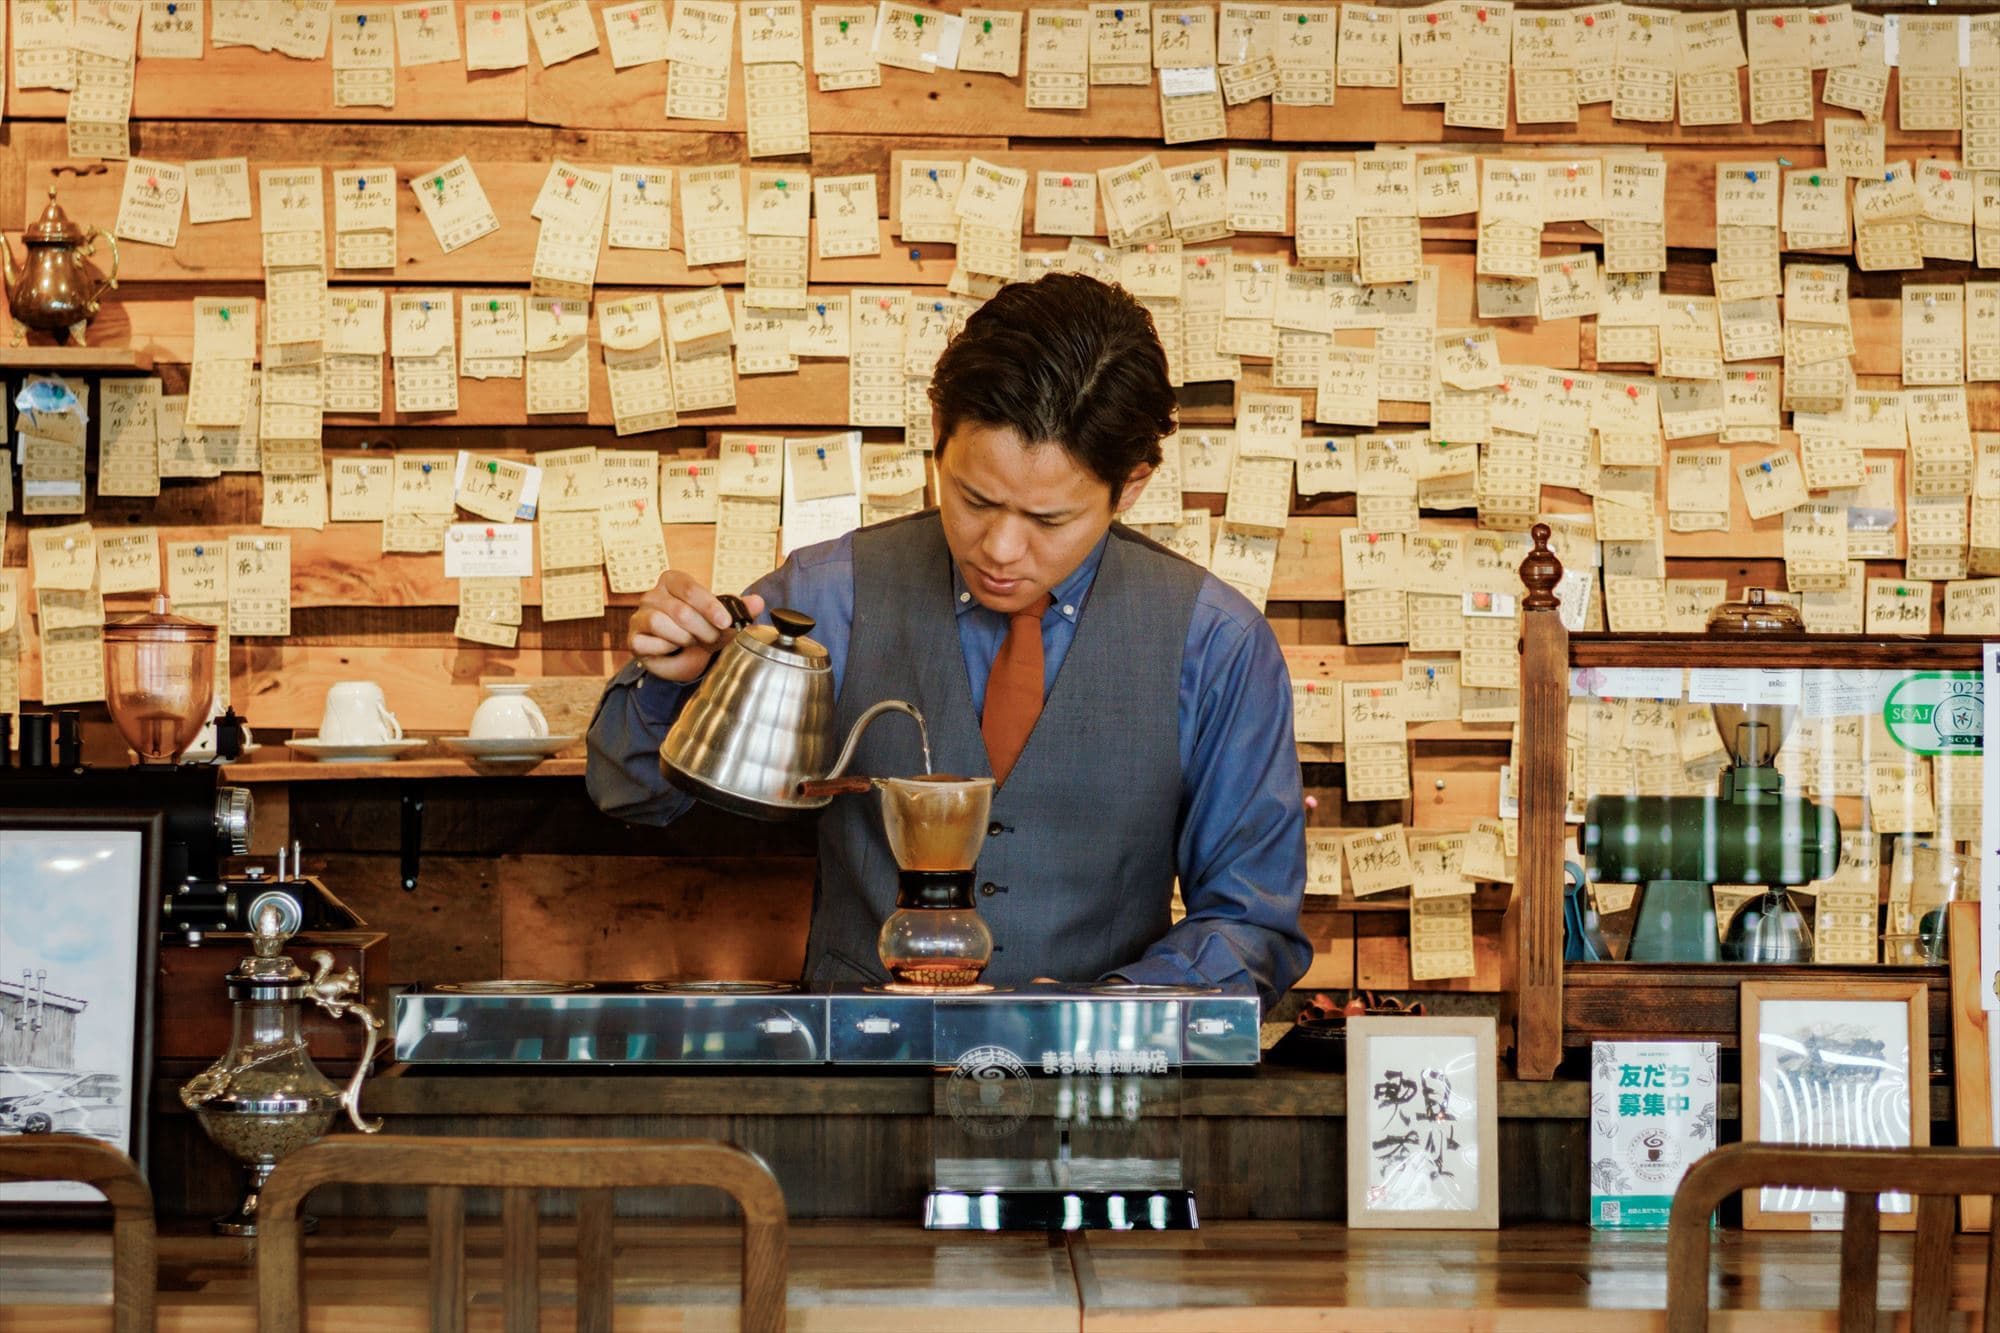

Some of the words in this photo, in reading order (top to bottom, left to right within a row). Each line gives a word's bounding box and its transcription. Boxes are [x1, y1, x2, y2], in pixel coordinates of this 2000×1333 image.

[1943, 682, 1984, 694] 2022
[1892, 708, 1930, 720] SCAJ
[1618, 1063, 1690, 1088] 友だち
[1618, 1093, 1690, 1117] 募集中
